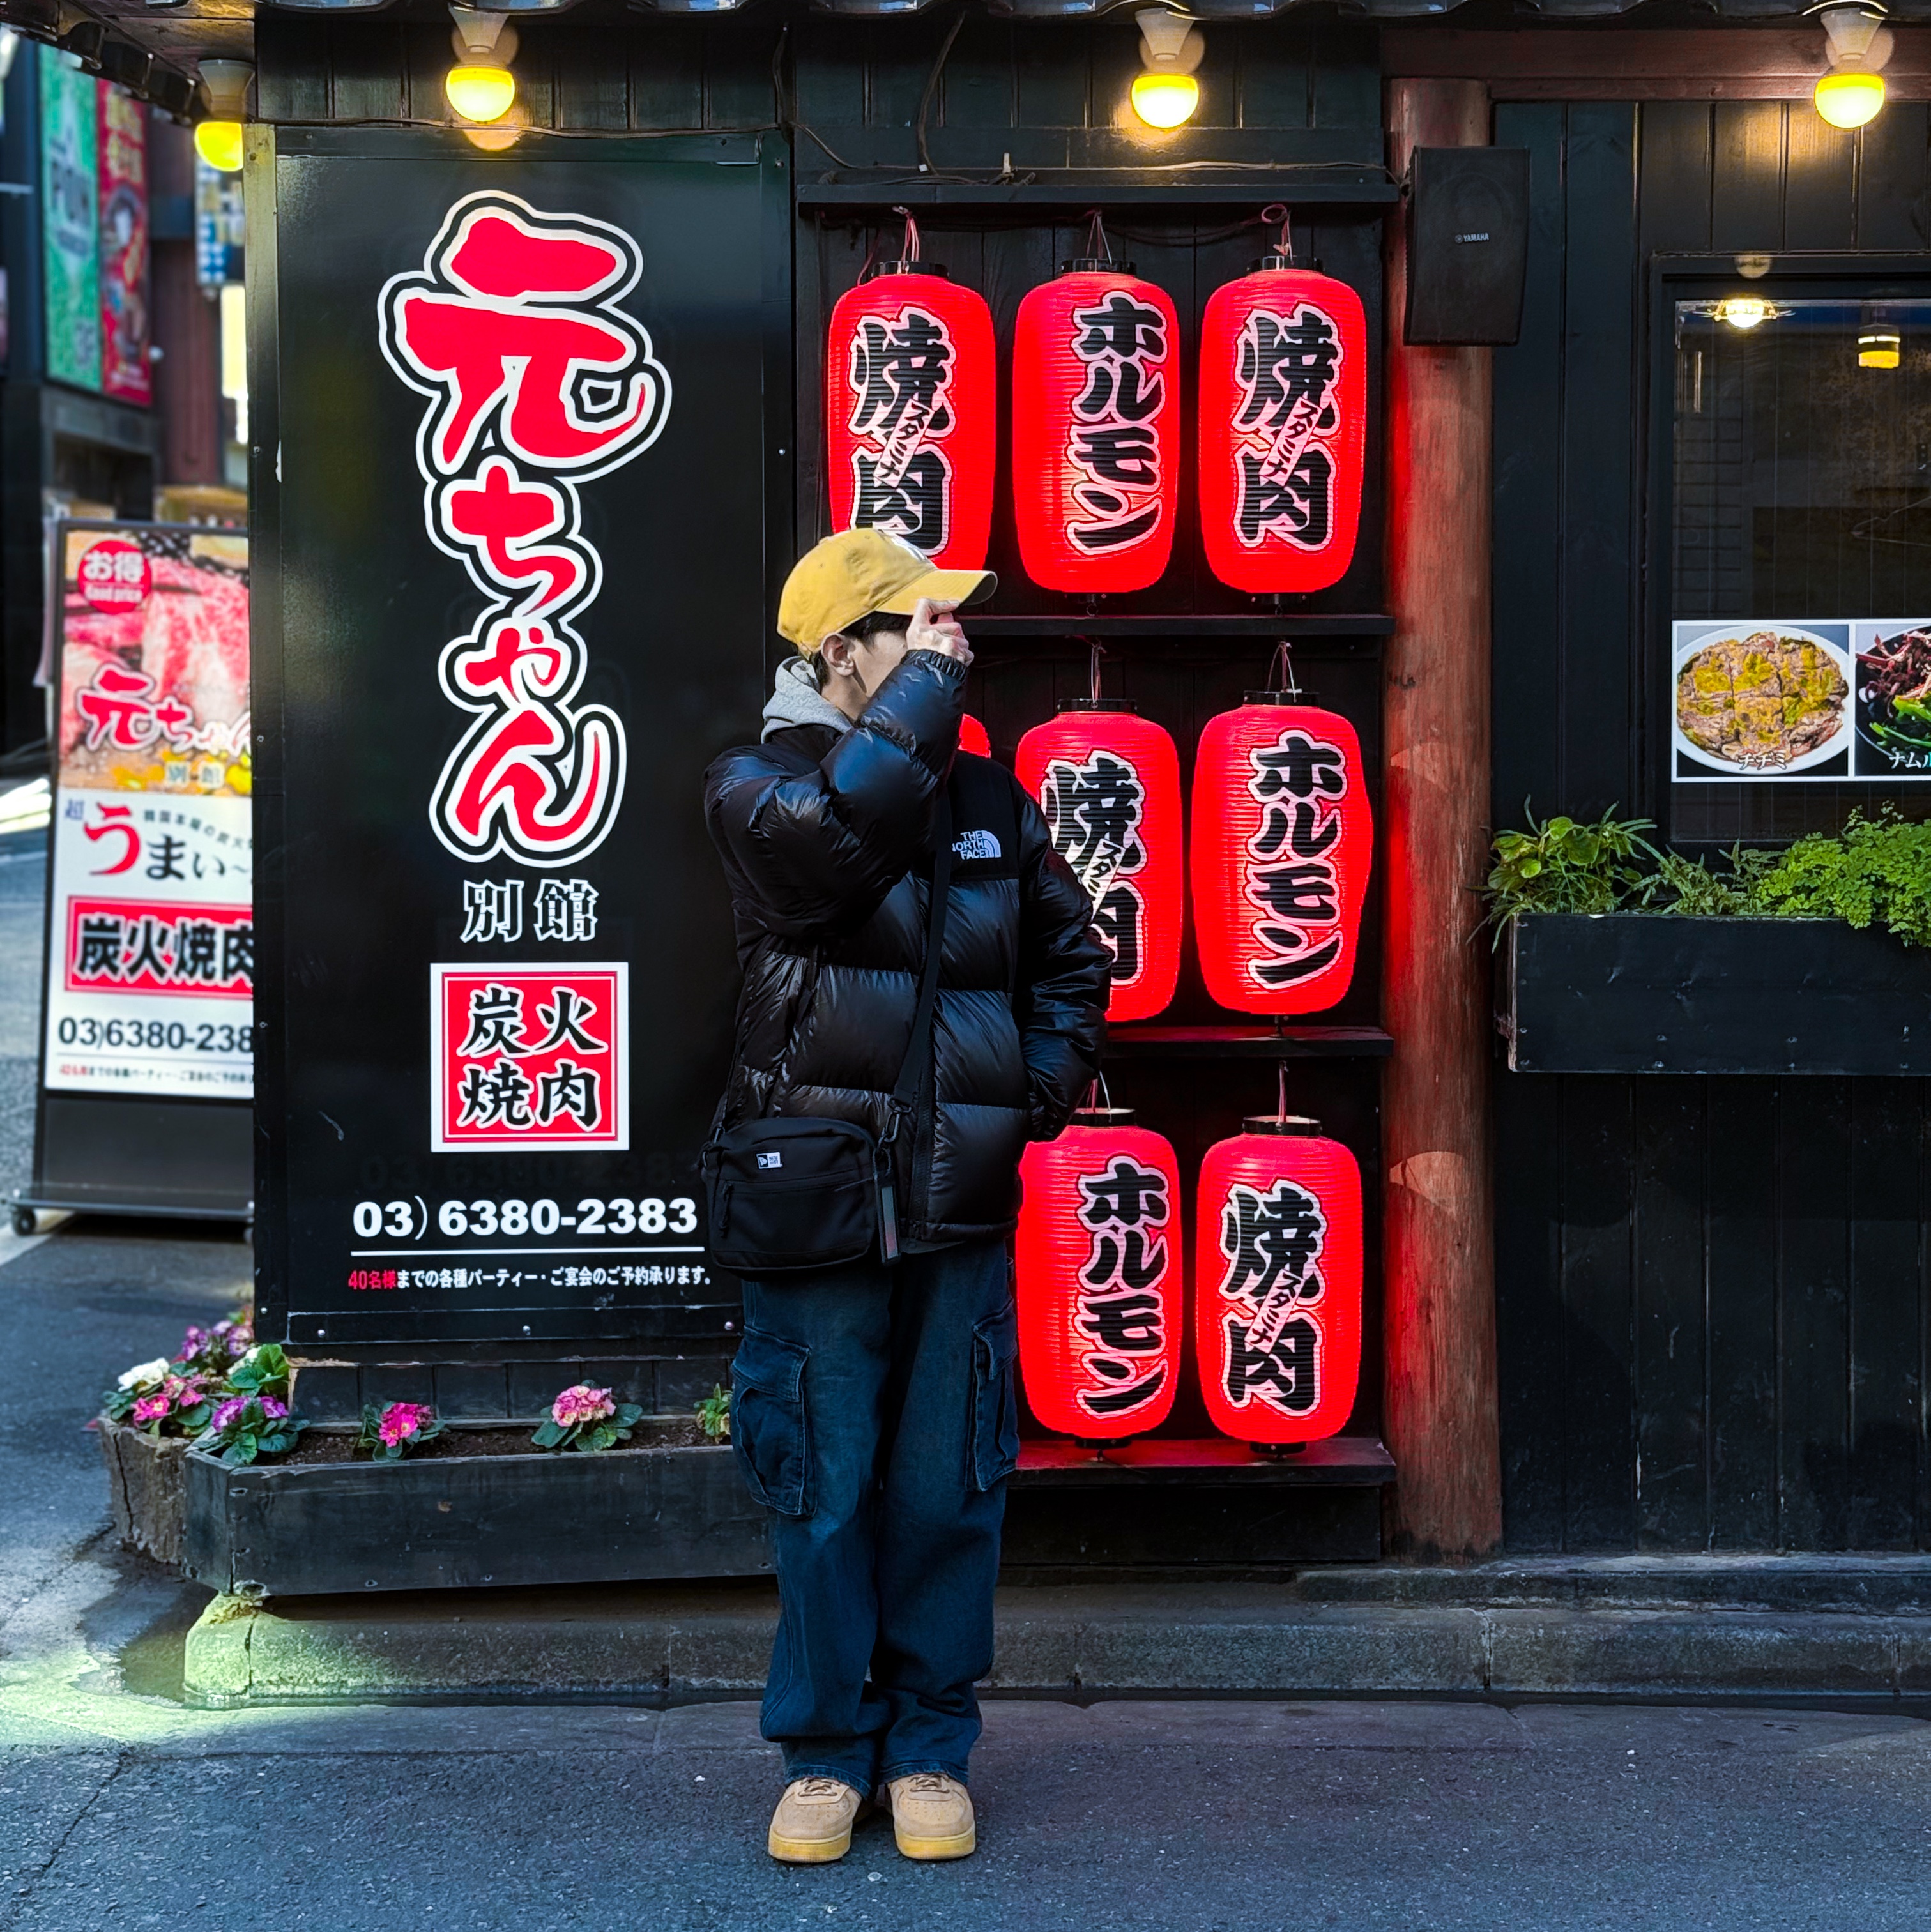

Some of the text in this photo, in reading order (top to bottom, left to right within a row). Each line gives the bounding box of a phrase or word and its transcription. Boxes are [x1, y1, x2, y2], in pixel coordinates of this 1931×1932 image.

[1463, 232, 1489, 242] YAMAHA
[849, 304, 956, 556] 焼肉
[880, 402, 934, 480] スタミナ
[1065, 291, 1168, 555] ホルモン
[1233, 302, 1344, 551] 焼肉
[1266, 400, 1320, 478] スタミナ
[390, 201, 659, 855] 元ちゃん
[83, 550, 144, 583] お得
[1738, 753, 1787, 771] チヂミ
[960, 832, 983, 841] THE
[961, 849, 986, 860] FACE
[1247, 730, 1347, 990] ホルモン
[460, 879, 600, 942] 別館
[456, 983, 609, 1058] 炭火
[456, 1057, 602, 1132] 焼肉
[1072, 1155, 1169, 1418] ホルモン
[1219, 1180, 1327, 1417] 焼肉
[1250, 1273, 1302, 1345] スタミナ
